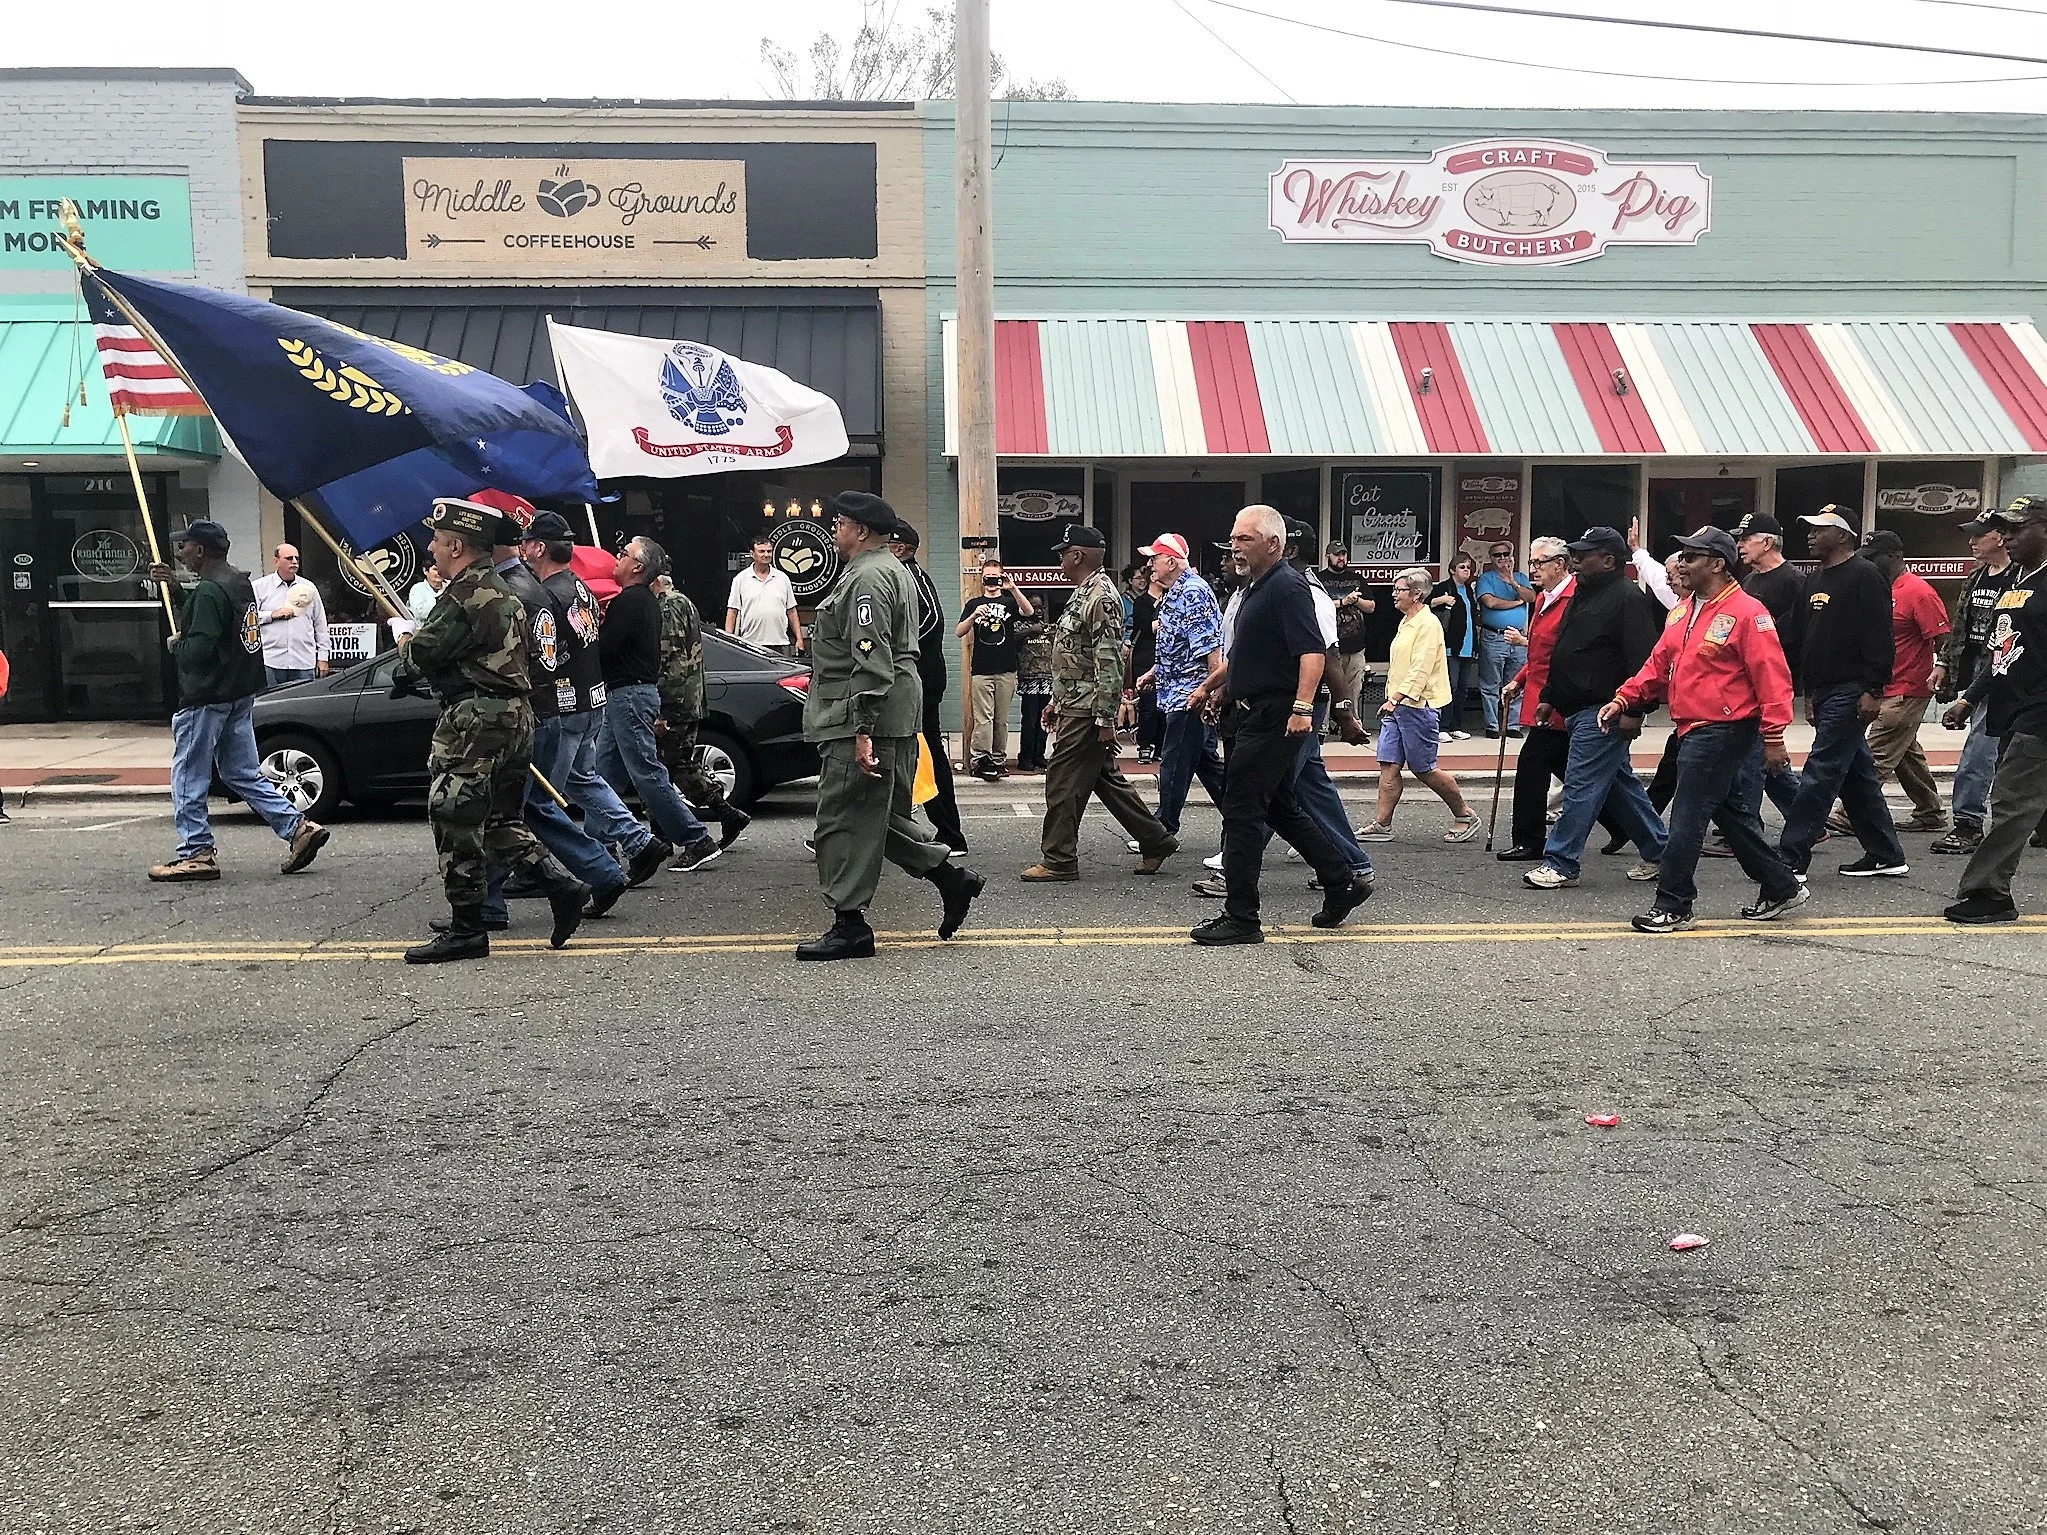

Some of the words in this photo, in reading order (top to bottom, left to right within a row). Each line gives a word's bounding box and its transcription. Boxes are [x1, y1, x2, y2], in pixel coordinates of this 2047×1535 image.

[1481, 149, 1558, 167] CRAFT
[1441, 182, 1460, 192] EST.
[1577, 184, 1597, 194] 2015
[413, 179, 526, 219] Middle
[608, 181, 737, 226] Grounds
[1283, 169, 1443, 231] Whiskey
[1601, 170, 1697, 231] Pig
[4, 232, 86, 252] MOR
[503, 234, 636, 249] COFFEEHOUSE
[1456, 234, 1580, 256] BUTCHERY
[708, 455, 736, 465] 1775
[746, 445, 784, 457] ARMY
[1350, 484, 1382, 506] Eat
[1363, 506, 1413, 529] Great
[771, 524, 793, 543] IDDLE
[1376, 530, 1423, 552] Meat
[1366, 550, 1400, 560] SOON
[1904, 562, 1965, 573] ARCUTERIE
[329, 636, 360, 650] AYOR
